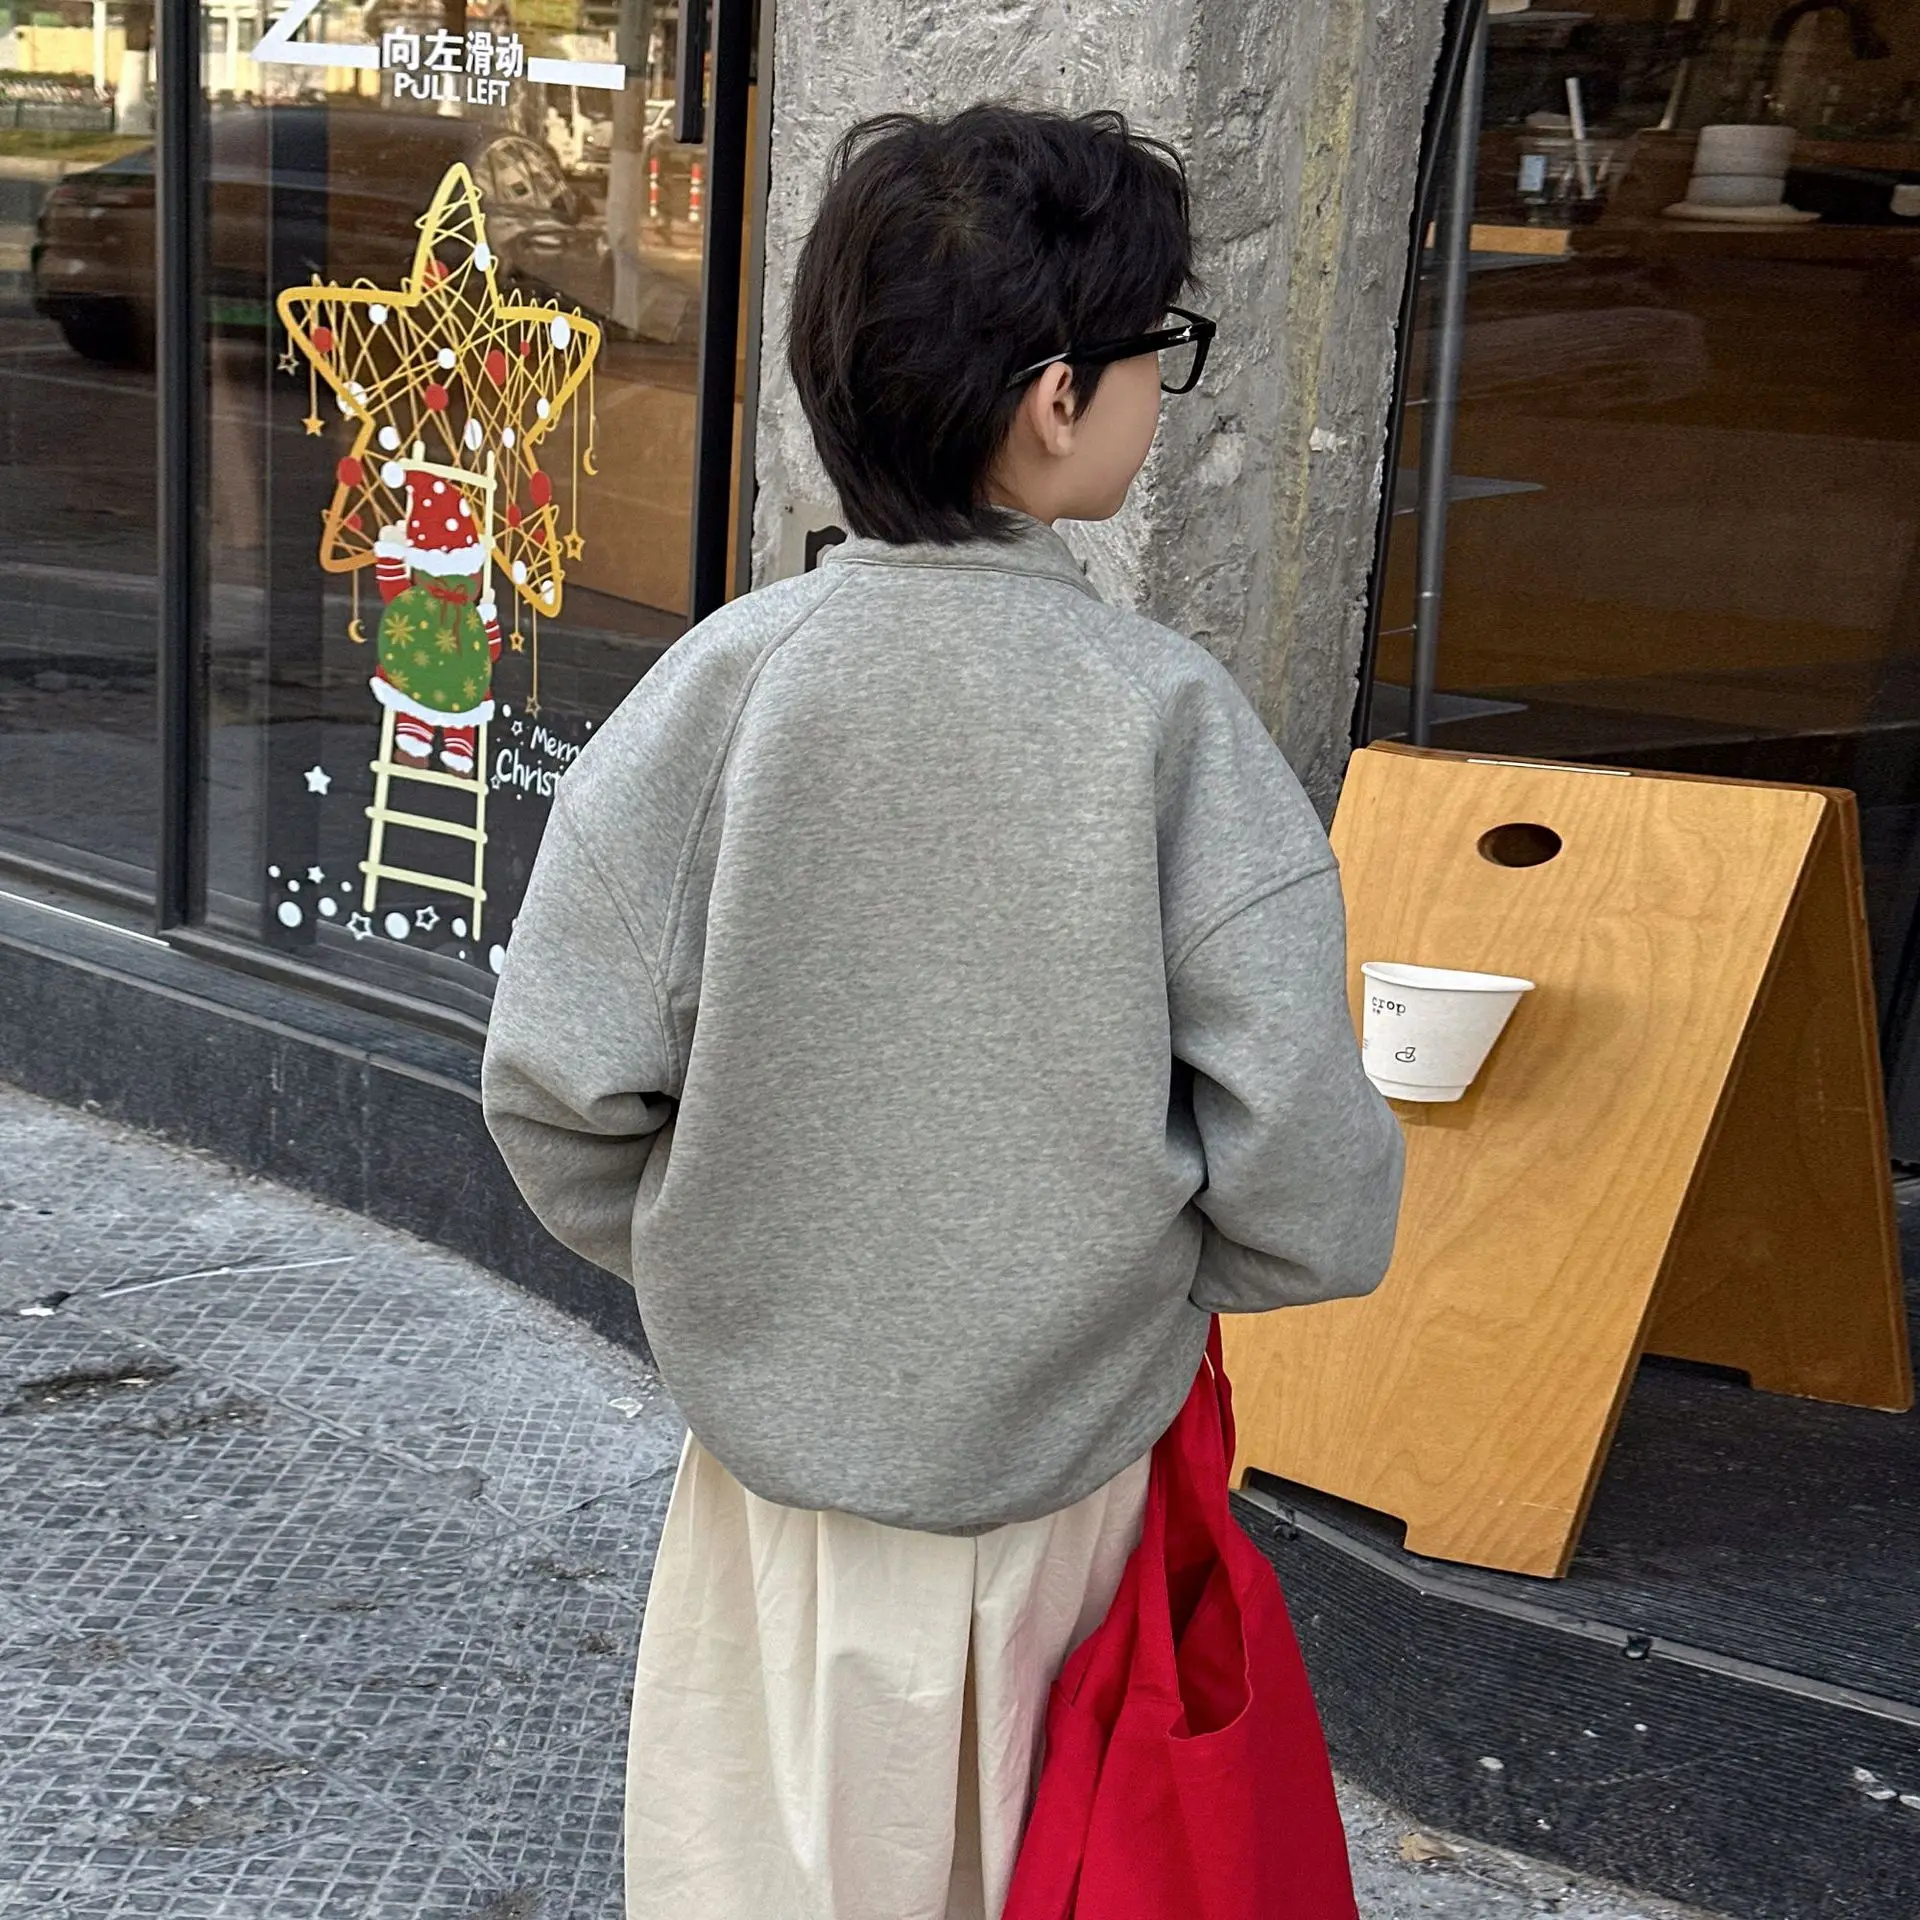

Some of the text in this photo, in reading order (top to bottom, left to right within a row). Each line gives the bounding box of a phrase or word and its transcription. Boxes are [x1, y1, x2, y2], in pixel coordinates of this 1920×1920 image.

[382, 25, 524, 78] 向左滑动
[394, 72, 510, 107] PULL LEFT
[530, 725, 581, 763] Merr
